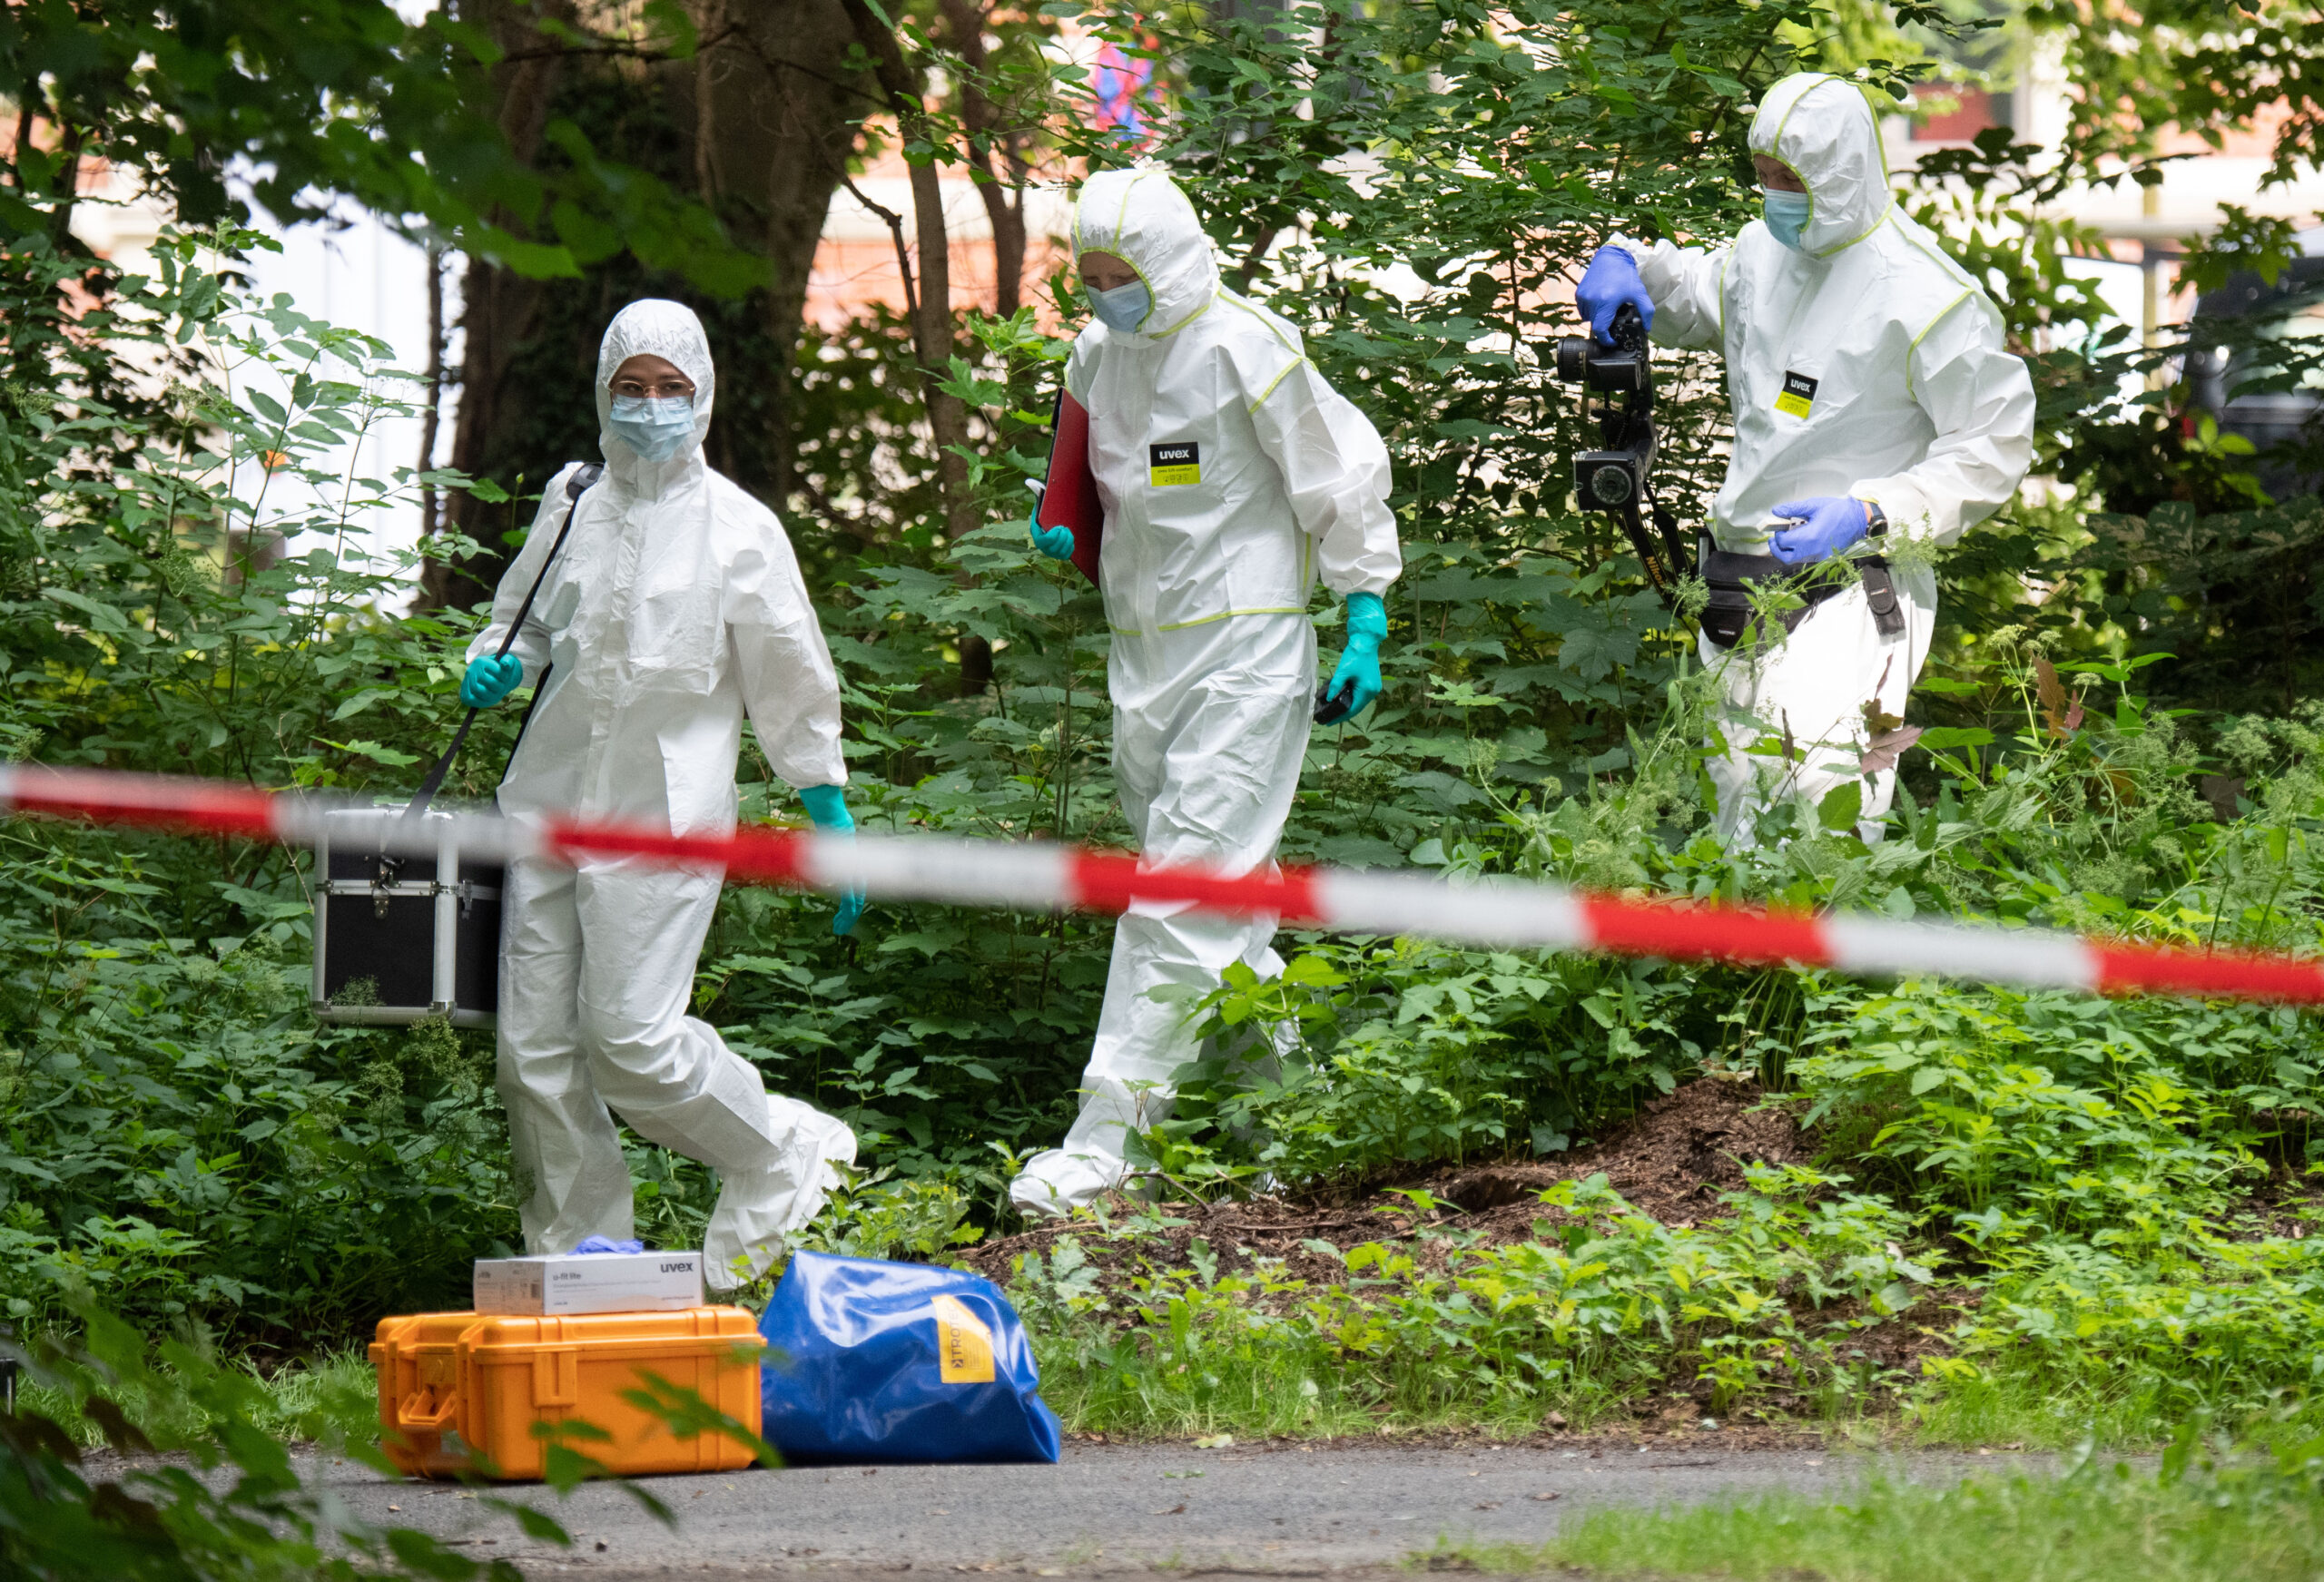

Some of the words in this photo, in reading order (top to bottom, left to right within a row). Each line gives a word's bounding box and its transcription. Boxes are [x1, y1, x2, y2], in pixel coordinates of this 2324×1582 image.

[1791, 378, 1811, 392] uvex
[1159, 449, 1189, 459] uvex
[661, 1262, 694, 1272] uvex
[552, 1272, 568, 1281] u-fit
[569, 1272, 582, 1280] lite
